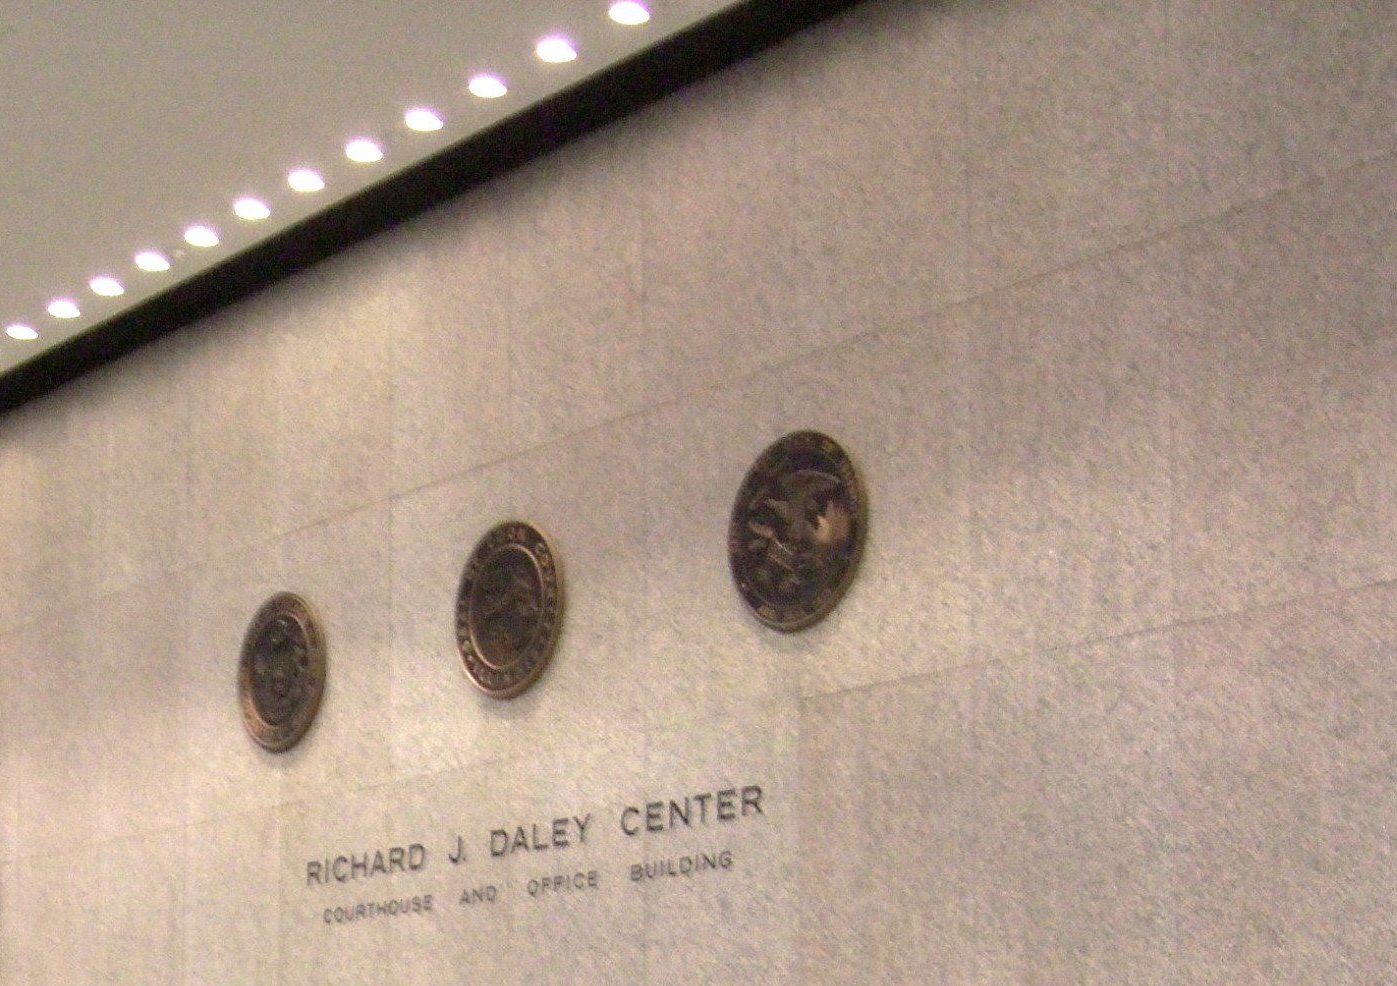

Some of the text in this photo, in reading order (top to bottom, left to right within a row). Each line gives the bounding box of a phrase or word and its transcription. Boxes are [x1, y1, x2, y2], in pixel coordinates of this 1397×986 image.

[306, 784, 764, 886] RICHARD J. DALEY CENTER
[323, 850, 734, 924] COURTHOUSE AND OFFICE BUILDING
